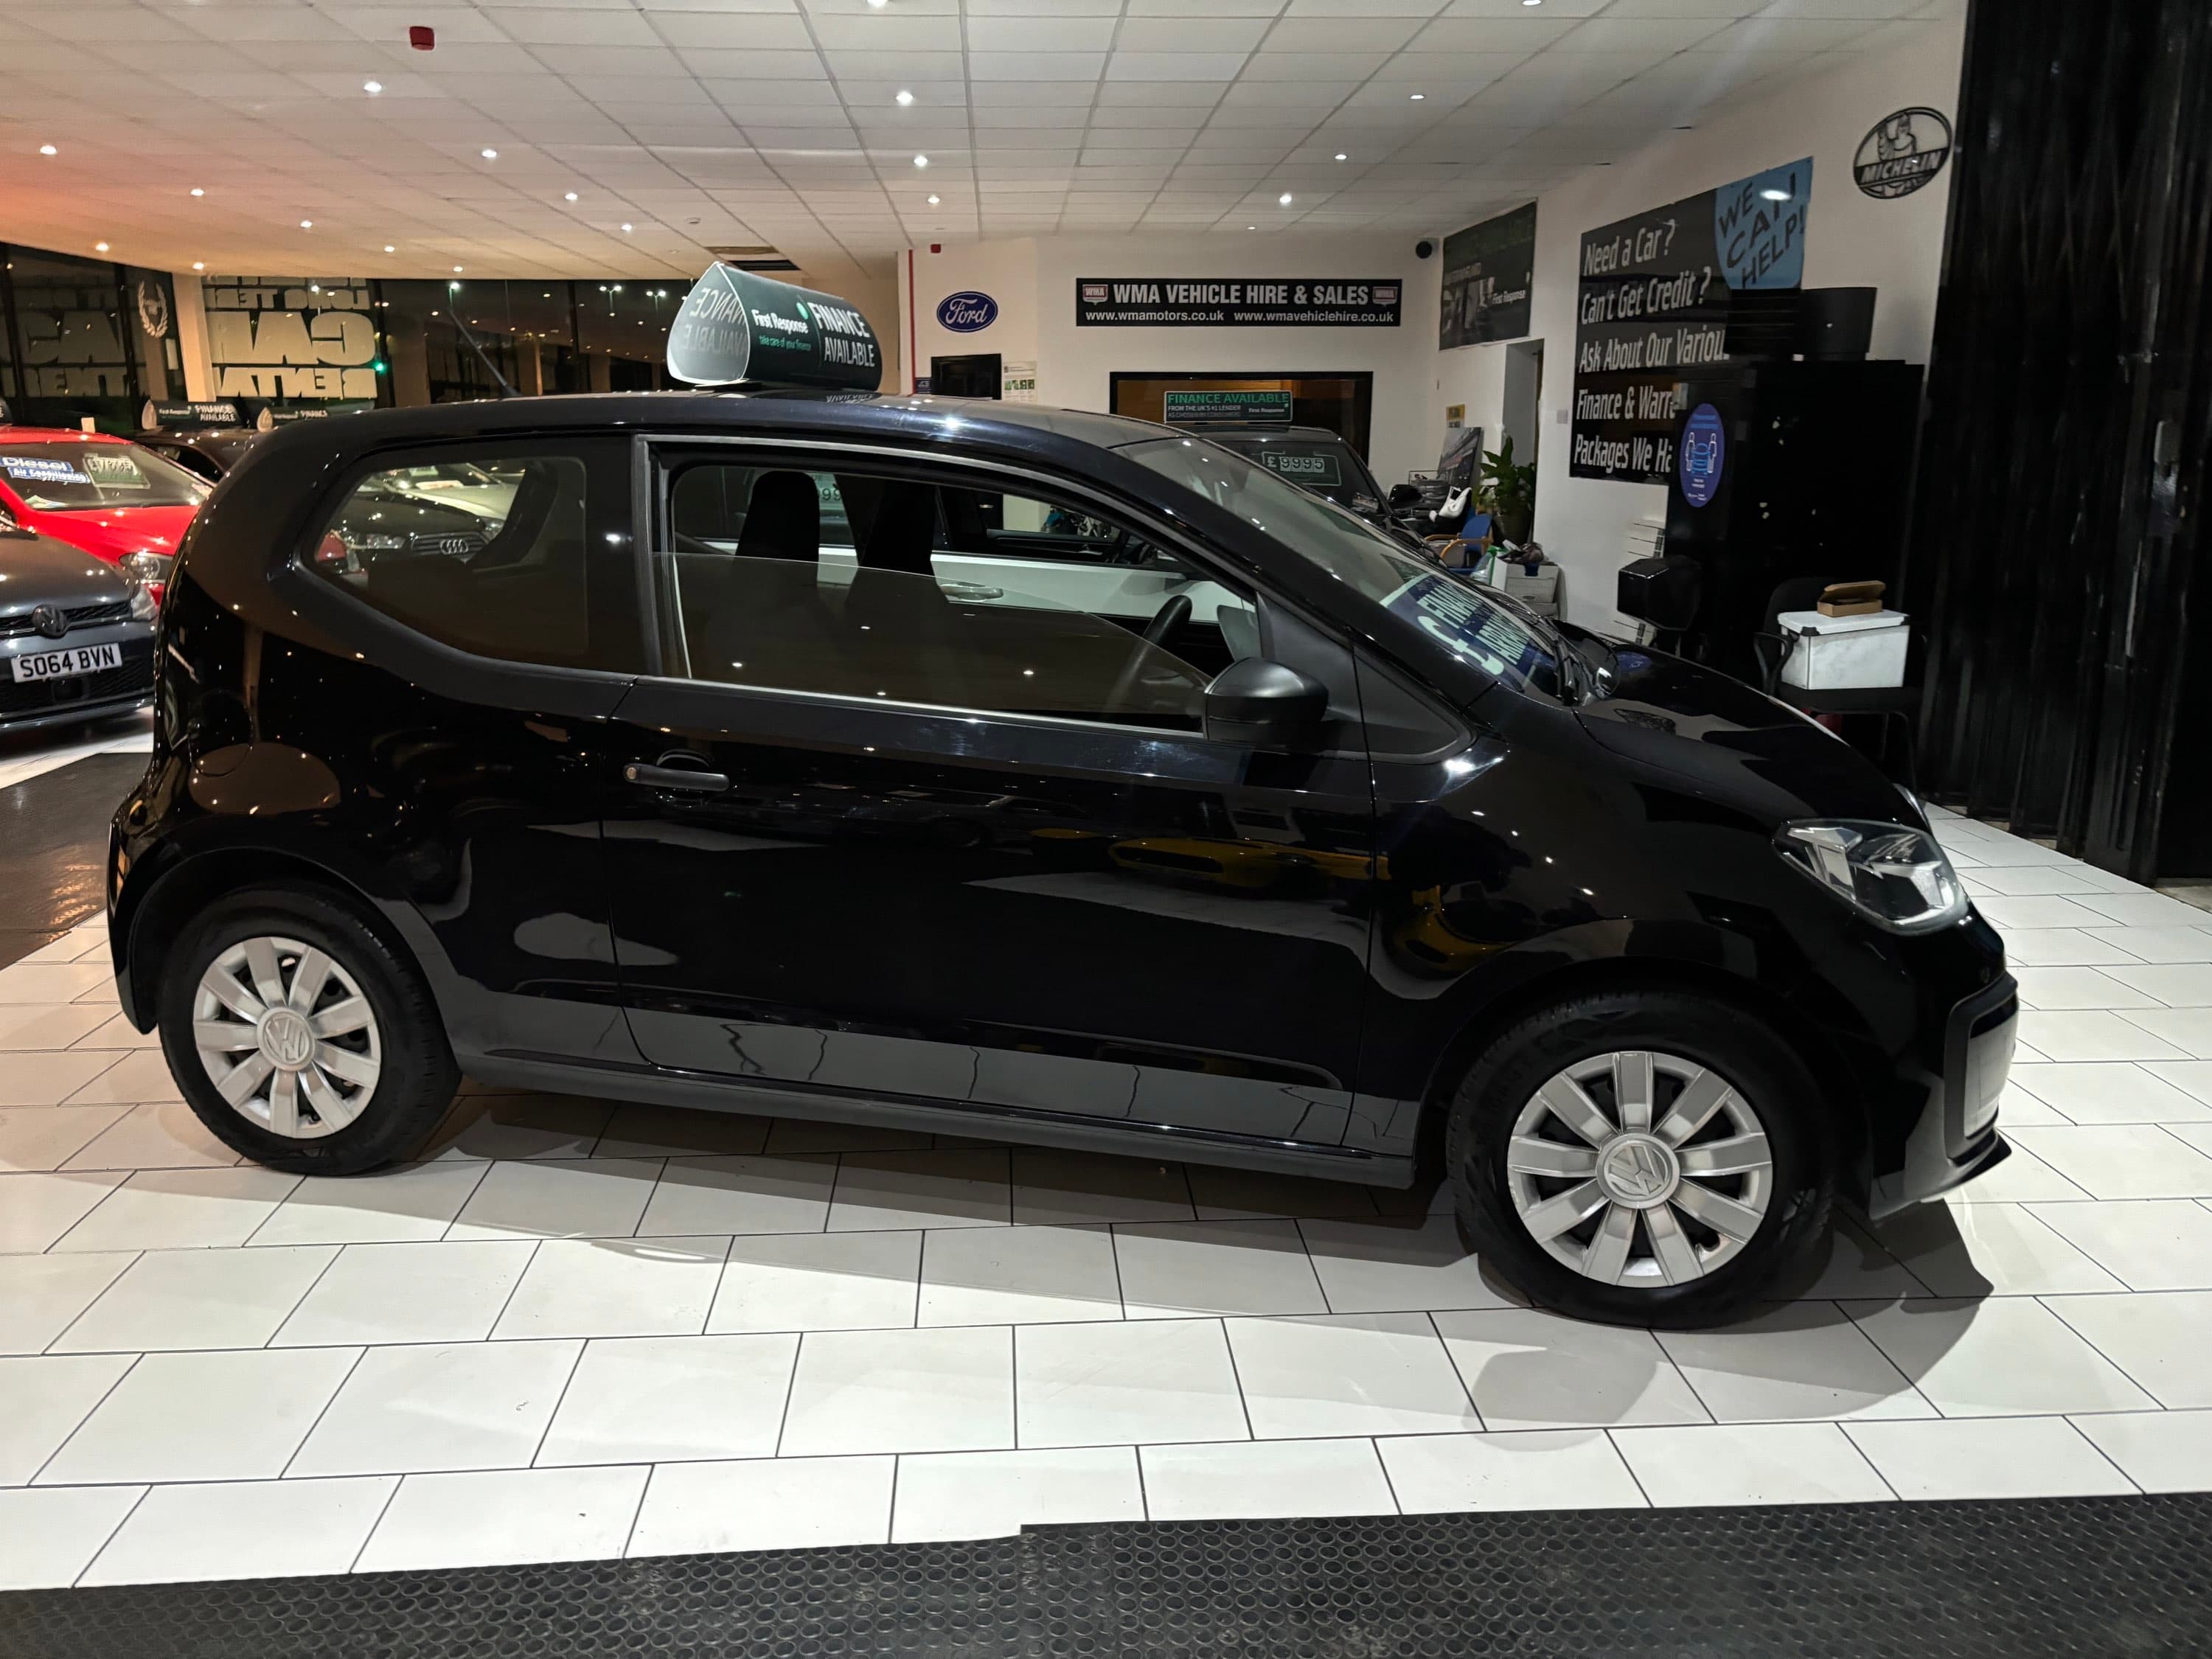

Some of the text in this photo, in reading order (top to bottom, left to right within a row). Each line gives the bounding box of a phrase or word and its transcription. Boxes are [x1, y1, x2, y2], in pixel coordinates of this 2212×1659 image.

[1861, 150, 1941, 183] MICHELIN
[1719, 182, 1753, 238] WE
[1583, 235, 1620, 276] Need
[1622, 238, 1632, 266] a
[1635, 227, 1663, 263] Car
[1741, 204, 1805, 289] HELP!
[1085, 287, 1105, 296] WMA
[1113, 284, 1369, 305] WMA VEHICLE HIRE & SALES
[1581, 290, 1615, 324] Can't
[1617, 284, 1644, 319] Get
[1646, 271, 1696, 313] Credit
[751, 309, 809, 335] First Response
[808, 302, 870, 338] FINANCE
[945, 299, 989, 324] Ford
[1085, 310, 1394, 322] www.wmamotors.co.uk www.wmavehiclehire.co.uk
[824, 336, 875, 368] AVAILABLE
[1579, 324, 1730, 373] Ask About Our Variou
[1167, 393, 1289, 403] FINANCE AVAILABLE
[1576, 389, 1621, 420] Finance
[1624, 386, 1635, 420] &
[1, 456, 67, 471] Diesel
[1267, 456, 1324, 470] £ 9995
[1573, 434, 1630, 474] Packages
[1632, 437, 1652, 470] We
[20, 646, 115, 678] SO64 BVN
